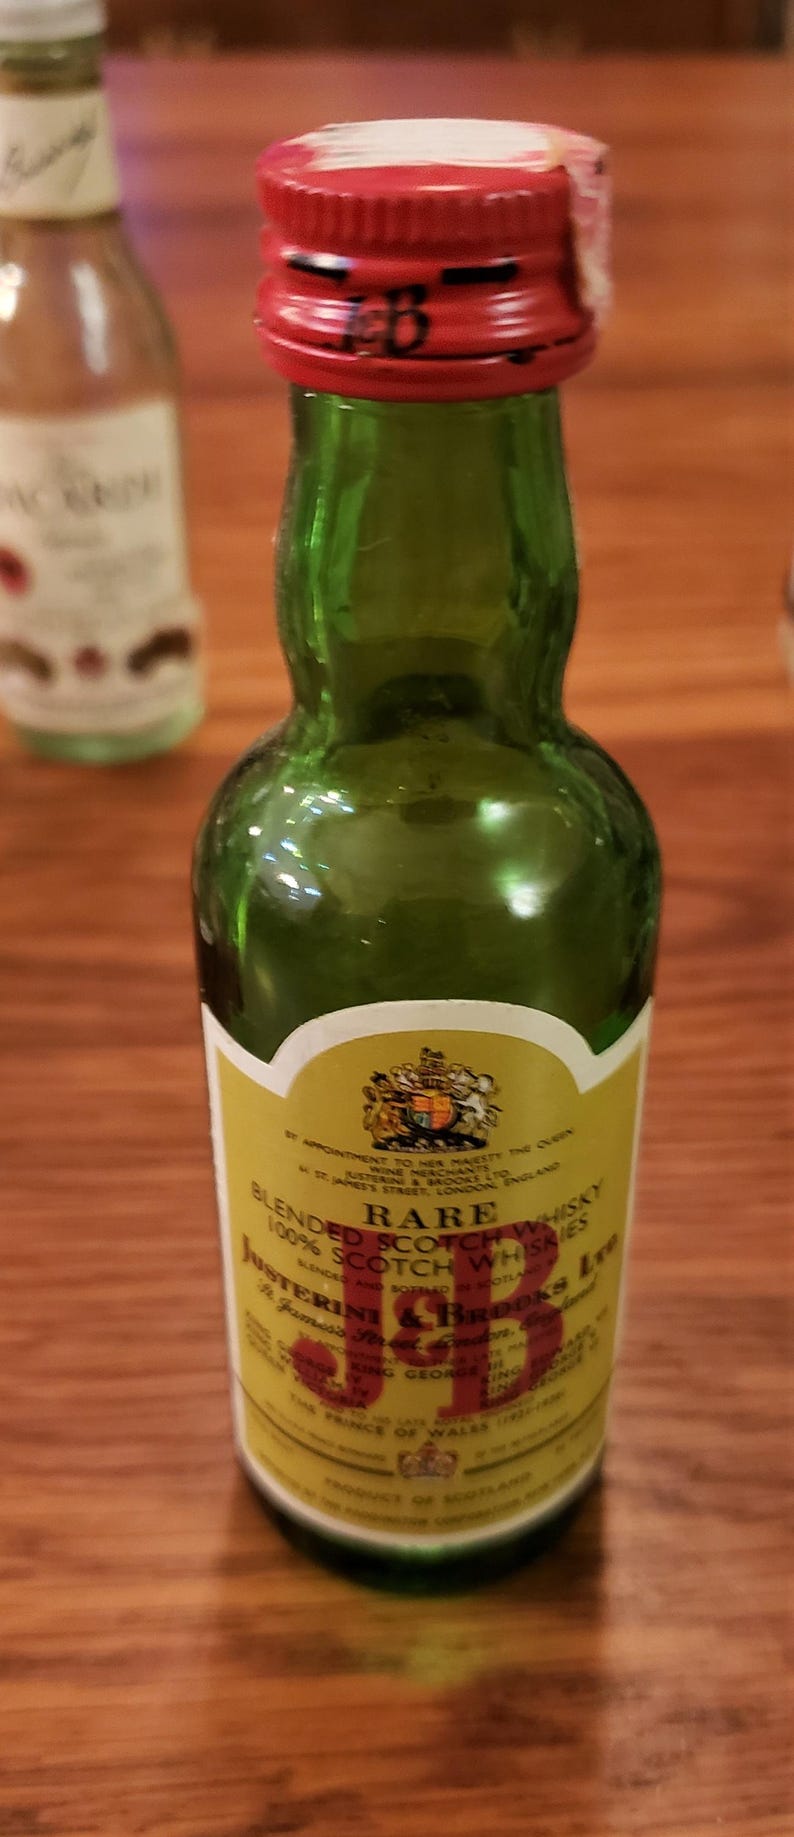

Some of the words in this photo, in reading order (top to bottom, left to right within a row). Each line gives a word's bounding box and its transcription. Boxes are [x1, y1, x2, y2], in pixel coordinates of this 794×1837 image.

[302, 1138, 388, 1164] APPOINTMENT
[394, 1158, 412, 1167] TO
[418, 1160, 444, 1168] HER
[451, 1152, 503, 1167] MAJESTY
[509, 1145, 531, 1155] THE
[537, 1128, 574, 1150] QUEEN
[345, 1170, 405, 1185] JUSTERINI
[427, 1174, 480, 1187] BROOKS
[369, 1165, 404, 1177] WINE
[410, 1165, 490, 1178] MERCHANTS
[502, 1161, 561, 1187] ENGLAND
[251, 1179, 364, 1247] BLENDED
[376, 1231, 504, 1254] SCOTCH
[511, 1177, 605, 1239] WHISKY
[363, 1201, 497, 1229] RARE
[267, 1214, 322, 1257] 100%
[331, 1245, 455, 1277] SCOTCH
[467, 1211, 590, 1273] WHISKIES
[297, 1257, 347, 1283] BLENDED
[391, 1284, 449, 1295] BOTTLED
[476, 1264, 542, 1289] SCOTLAND
[399, 1306, 426, 1329] &
[351, 1361, 395, 1379] KING
[405, 1366, 480, 1381] GEORGE
[324, 1409, 385, 1436] PRINCE
[393, 1426, 418, 1438] OF
[428, 1421, 489, 1438] WALES
